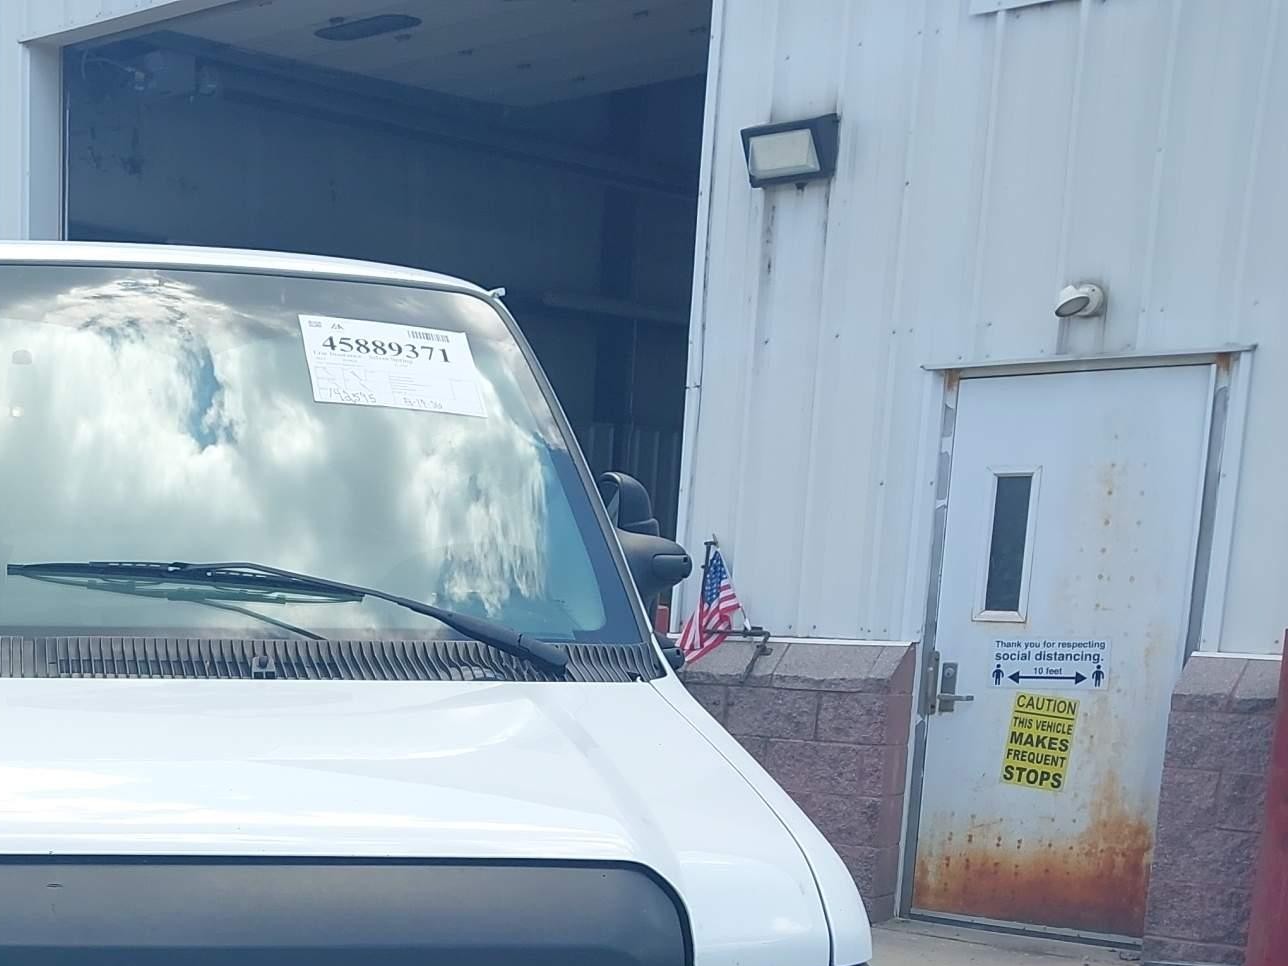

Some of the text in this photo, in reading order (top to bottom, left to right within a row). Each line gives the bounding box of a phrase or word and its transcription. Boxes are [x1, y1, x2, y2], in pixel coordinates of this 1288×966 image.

[321, 335, 451, 363] 45889371
[995, 640, 1106, 650] Thank you for respecting
[995, 650, 1104, 664] social distancing.
[1033, 667, 1062, 675] 10 feet
[1016, 694, 1078, 716] CAUTION
[1013, 716, 1074, 735] THIS VEHICLE
[1009, 731, 1070, 753] MAKES
[1006, 749, 1067, 768] FREQUENT
[1003, 765, 1063, 789] STOPS
